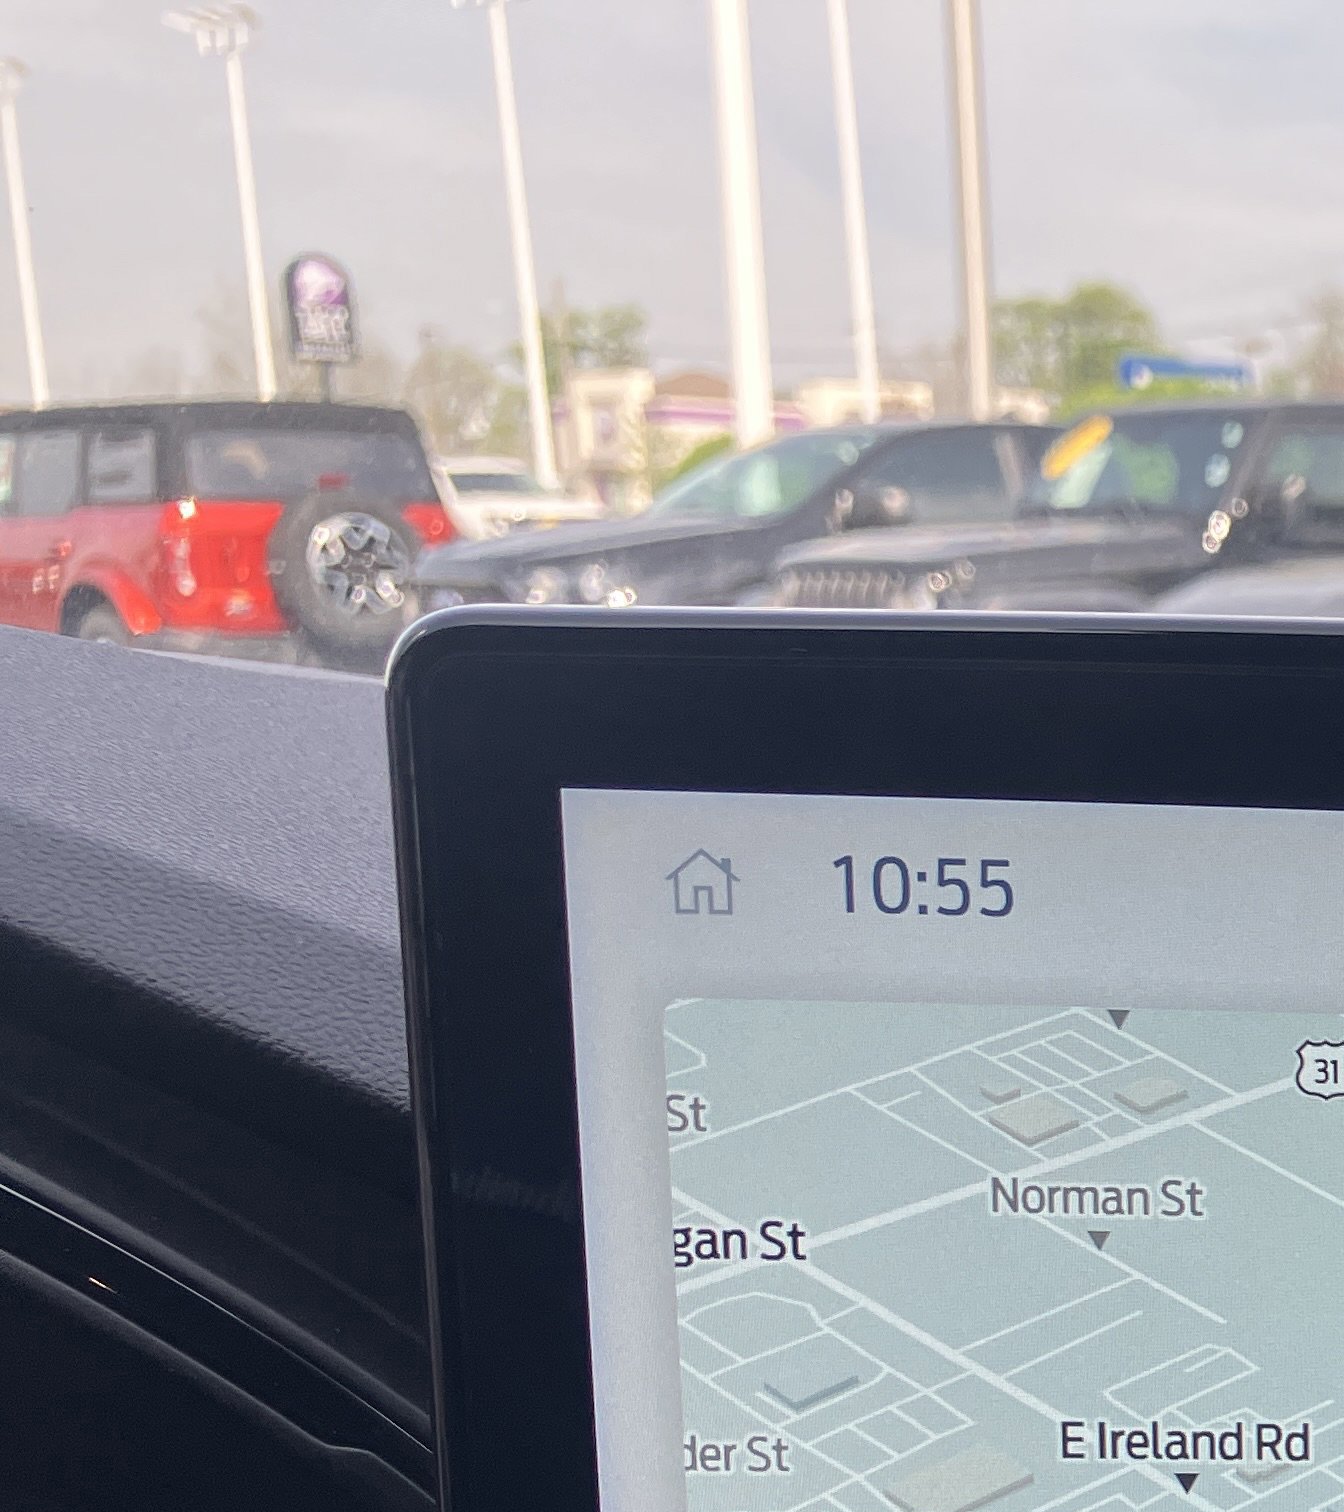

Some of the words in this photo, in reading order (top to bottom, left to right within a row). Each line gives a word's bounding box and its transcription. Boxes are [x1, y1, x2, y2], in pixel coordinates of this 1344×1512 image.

[833, 855, 1014, 918] 10:55
[1314, 1058, 1339, 1084] 31
[667, 1094, 707, 1132] St
[991, 1176, 1149, 1216] Norman
[1161, 1179, 1204, 1217] St
[759, 1220, 807, 1261] St
[746, 1435, 790, 1473] St
[1061, 1421, 1085, 1459] E
[1098, 1420, 1243, 1461] Ireland
[1256, 1422, 1309, 1462] Rd
